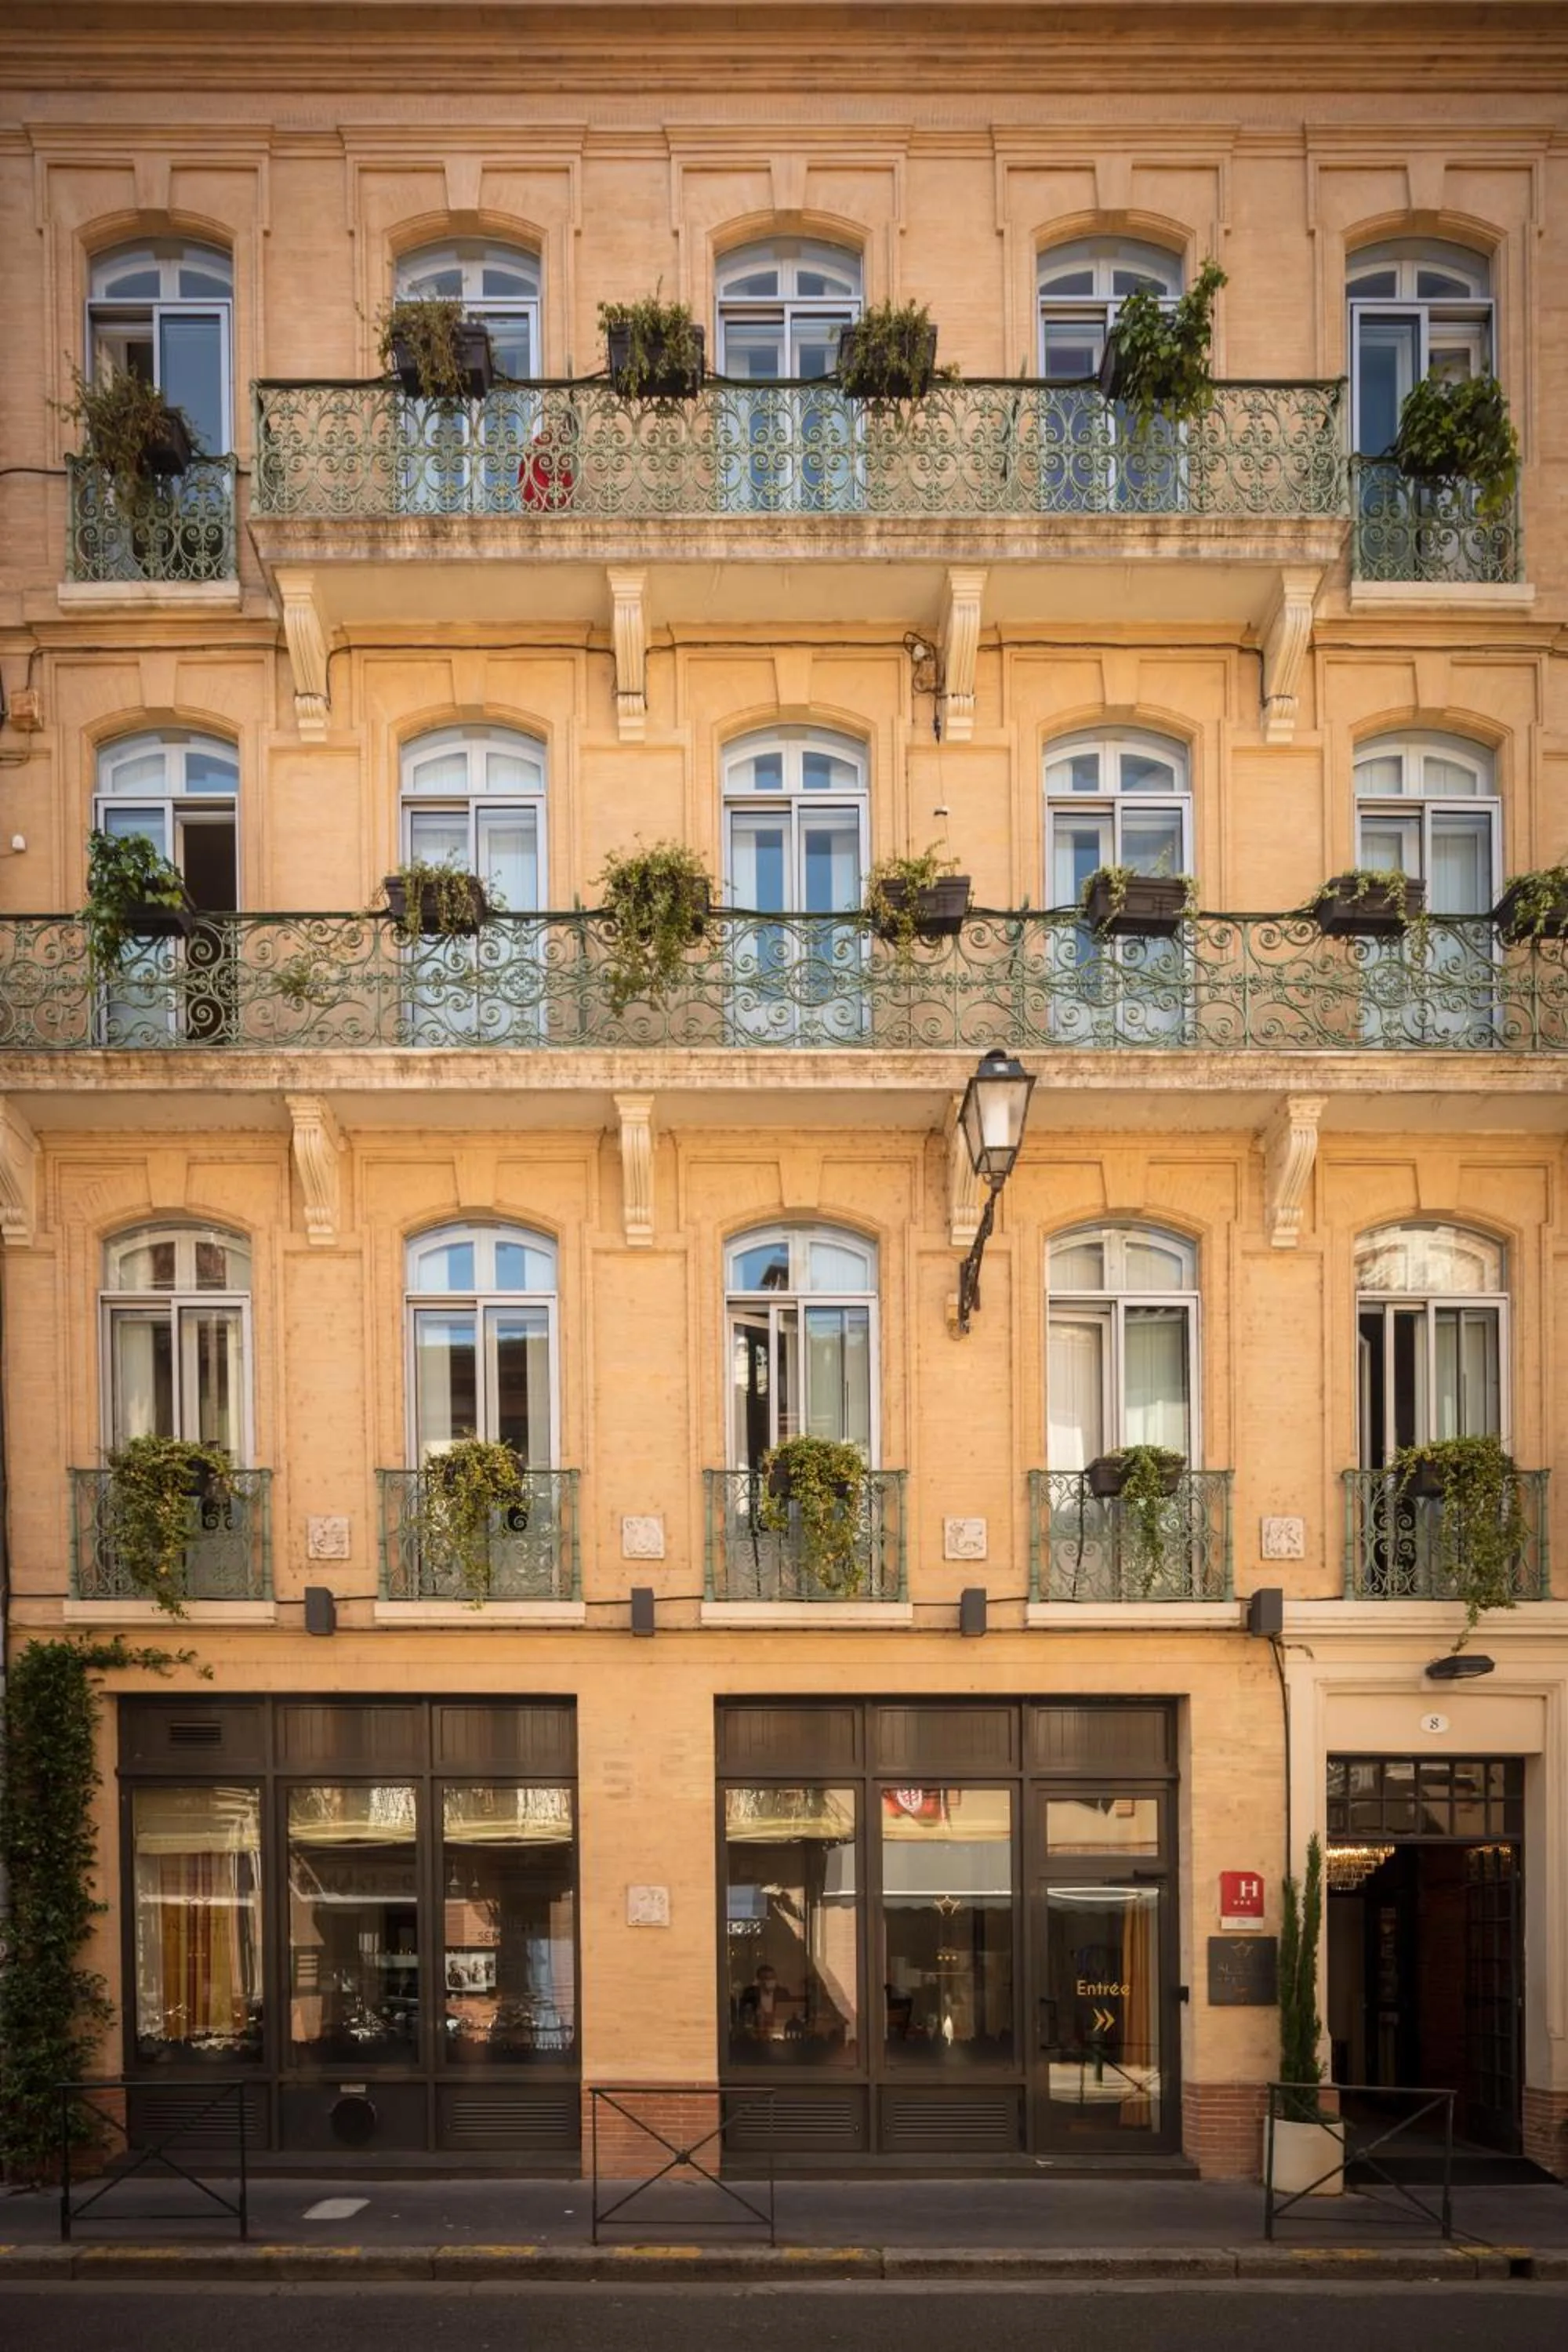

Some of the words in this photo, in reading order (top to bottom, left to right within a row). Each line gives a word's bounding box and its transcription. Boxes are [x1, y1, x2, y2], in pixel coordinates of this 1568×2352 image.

[1429, 1718, 1439, 1730] 8
[1241, 1882, 1258, 1897] H
[1076, 1980, 1130, 1995] Entrée
